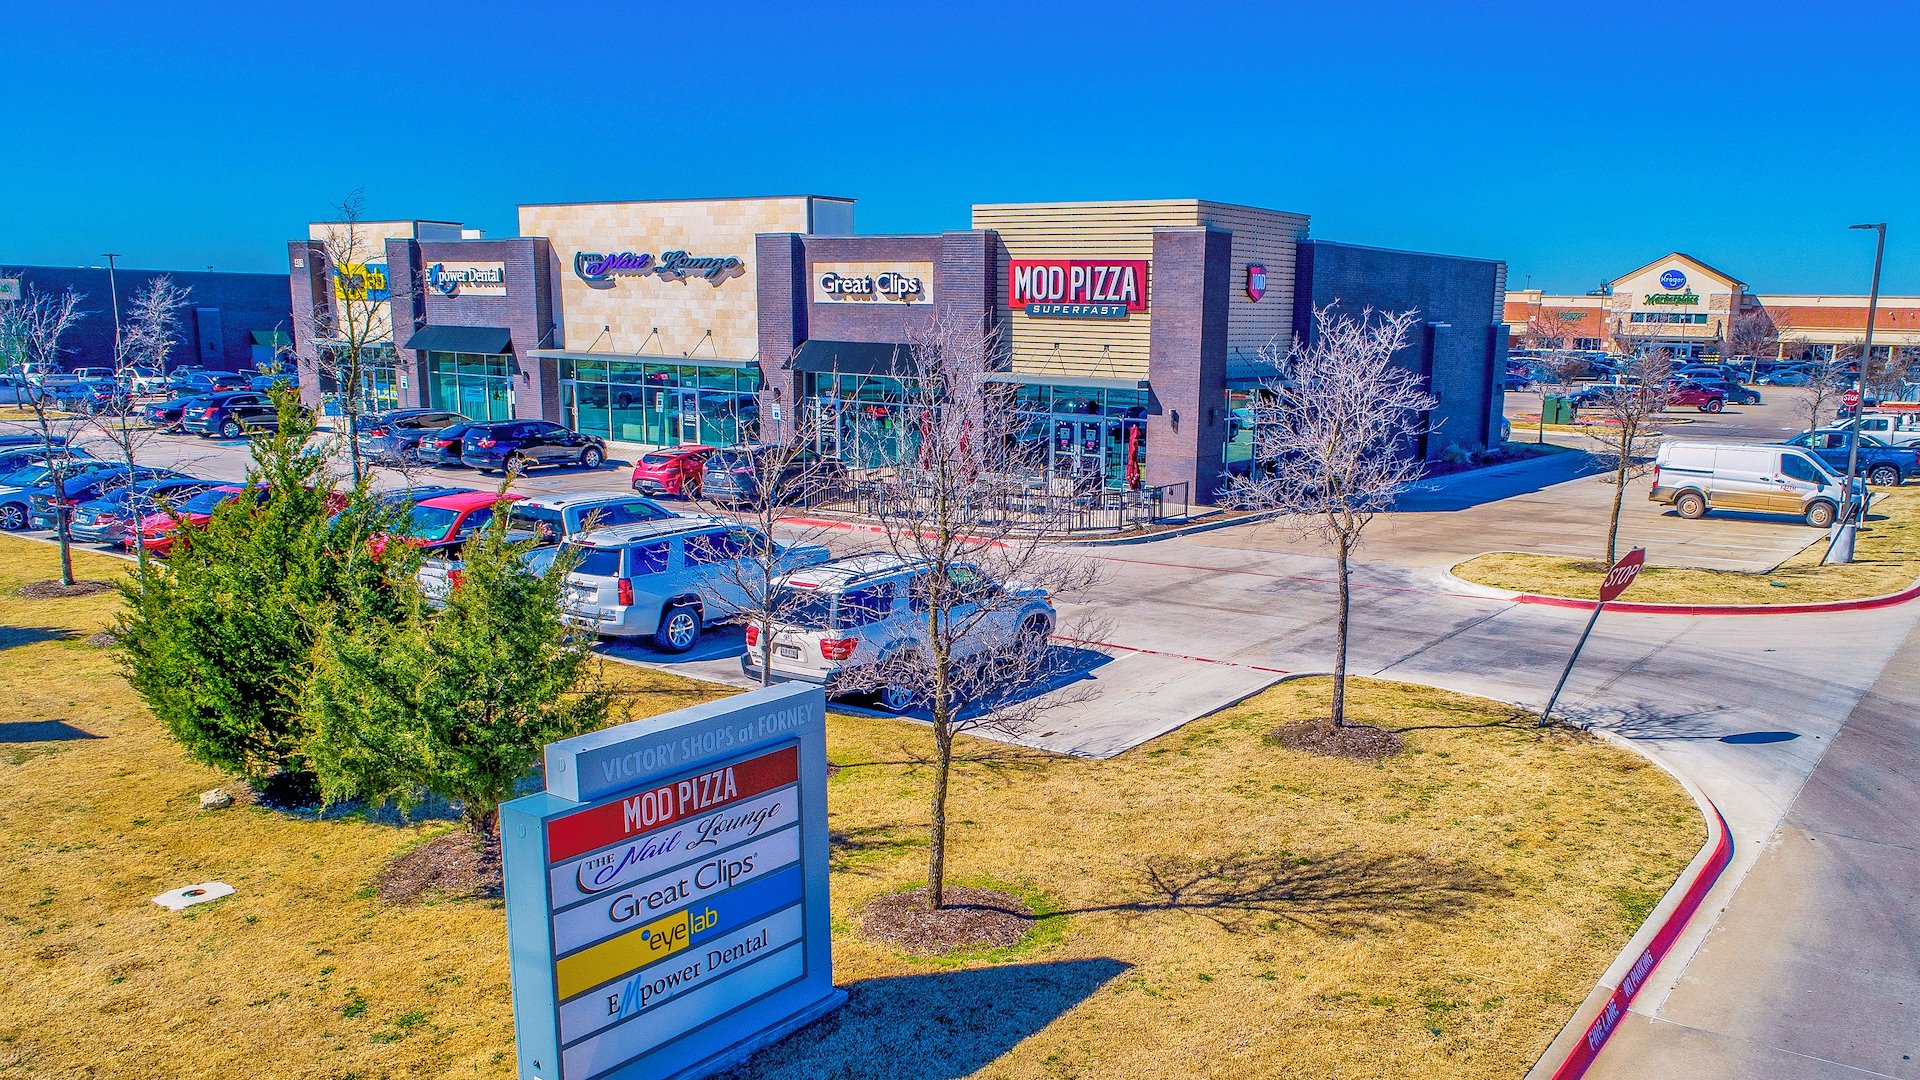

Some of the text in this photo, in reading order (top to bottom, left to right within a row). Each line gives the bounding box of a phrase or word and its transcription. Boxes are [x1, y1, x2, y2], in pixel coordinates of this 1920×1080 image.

[469, 268, 501, 282] Dental
[586, 252, 652, 275] Nail
[652, 251, 741, 280] Lounge
[1660, 273, 1686, 287] Kroger
[820, 273, 918, 299] Great Clips
[1015, 266, 1137, 301] MOD PIZZA
[1033, 305, 1119, 315] SUPERFAST
[1604, 564, 1640, 587] STOP
[601, 703, 814, 782] VICTORY SHOPS at FORNEY
[623, 767, 738, 833] MOD PIZZA
[586, 801, 782, 885] THE Nail Lounge
[609, 879, 690, 923] Great
[707, 928, 769, 972] Dental
[1588, 949, 1653, 1050] FIRE LANE NO PARKING
